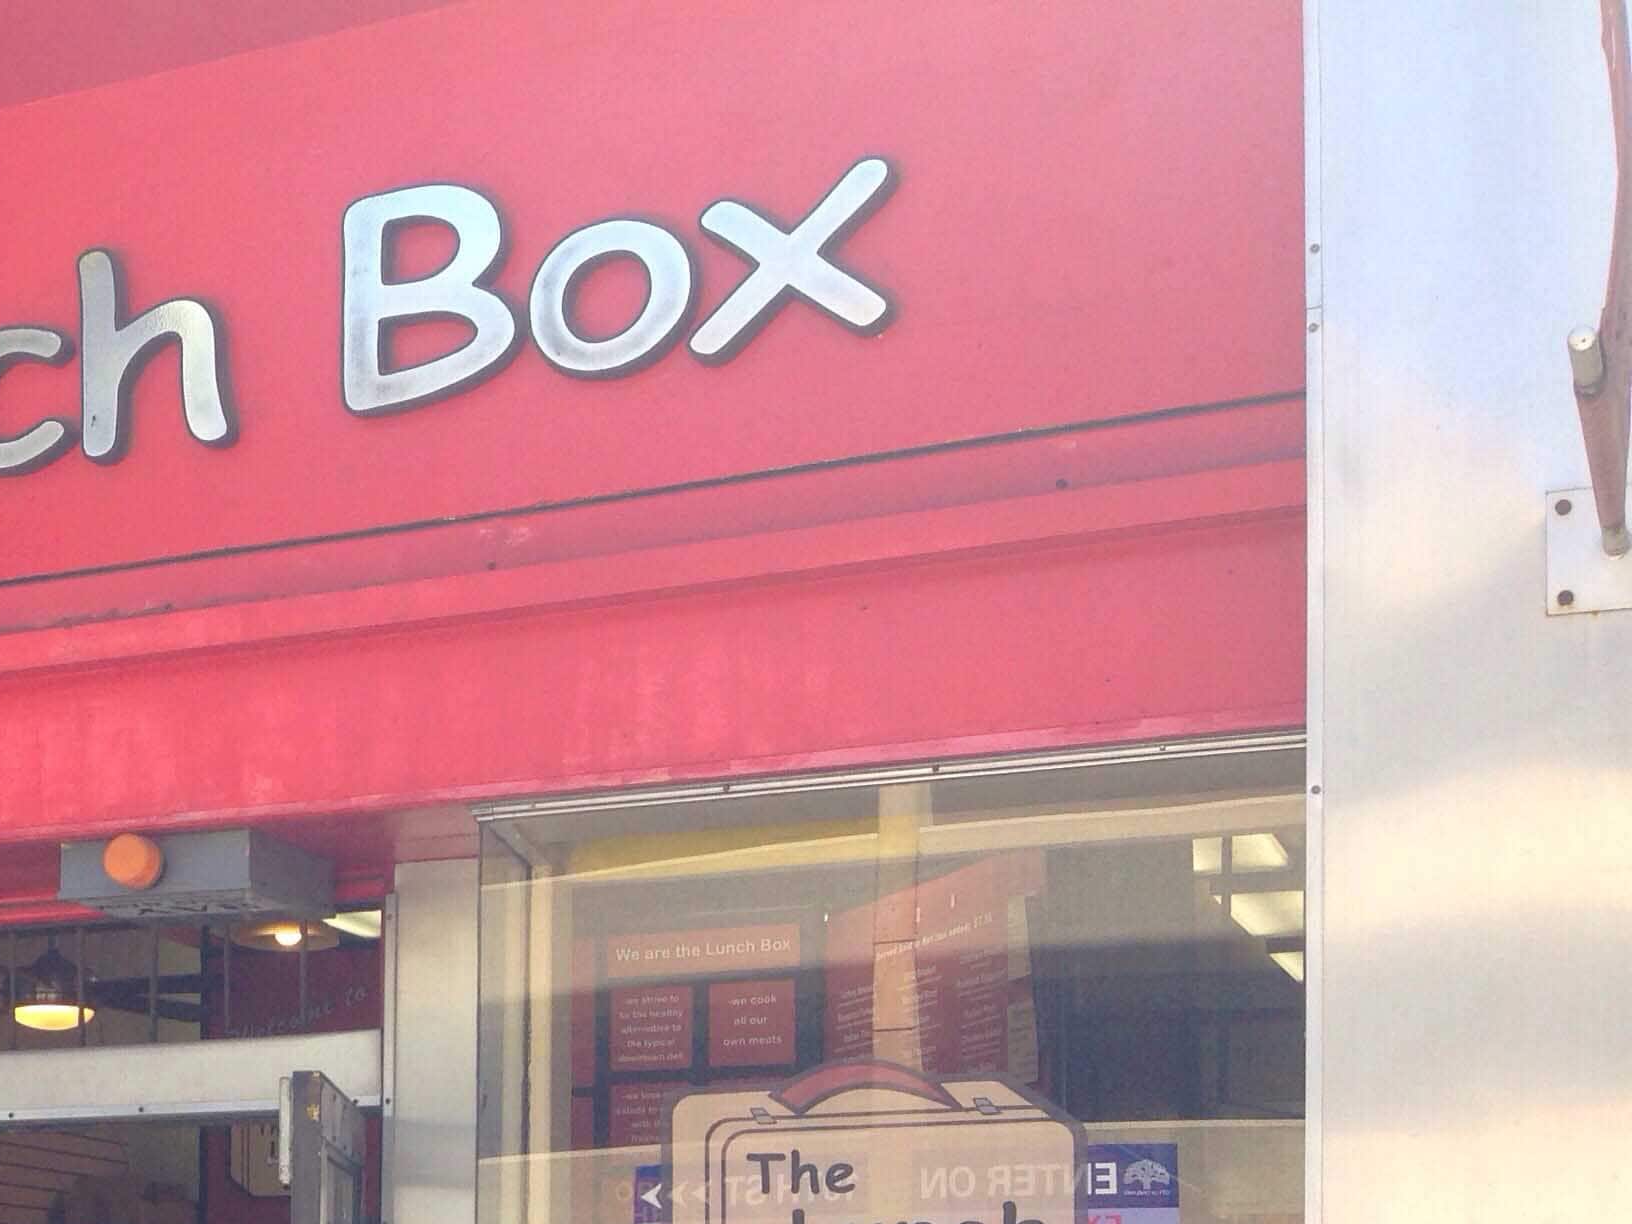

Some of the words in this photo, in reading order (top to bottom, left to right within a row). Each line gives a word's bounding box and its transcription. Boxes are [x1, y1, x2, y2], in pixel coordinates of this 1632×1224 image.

[340, 157, 895, 416] Box
[616, 948, 640, 961] We
[644, 948, 670, 960] are
[675, 944, 700, 958] the
[705, 940, 755, 956] Lunch
[760, 938, 792, 952] Box
[750, 993, 777, 1005] cook
[749, 1016, 769, 1026] our
[723, 1037, 746, 1047] own
[746, 1149, 856, 1194] The
